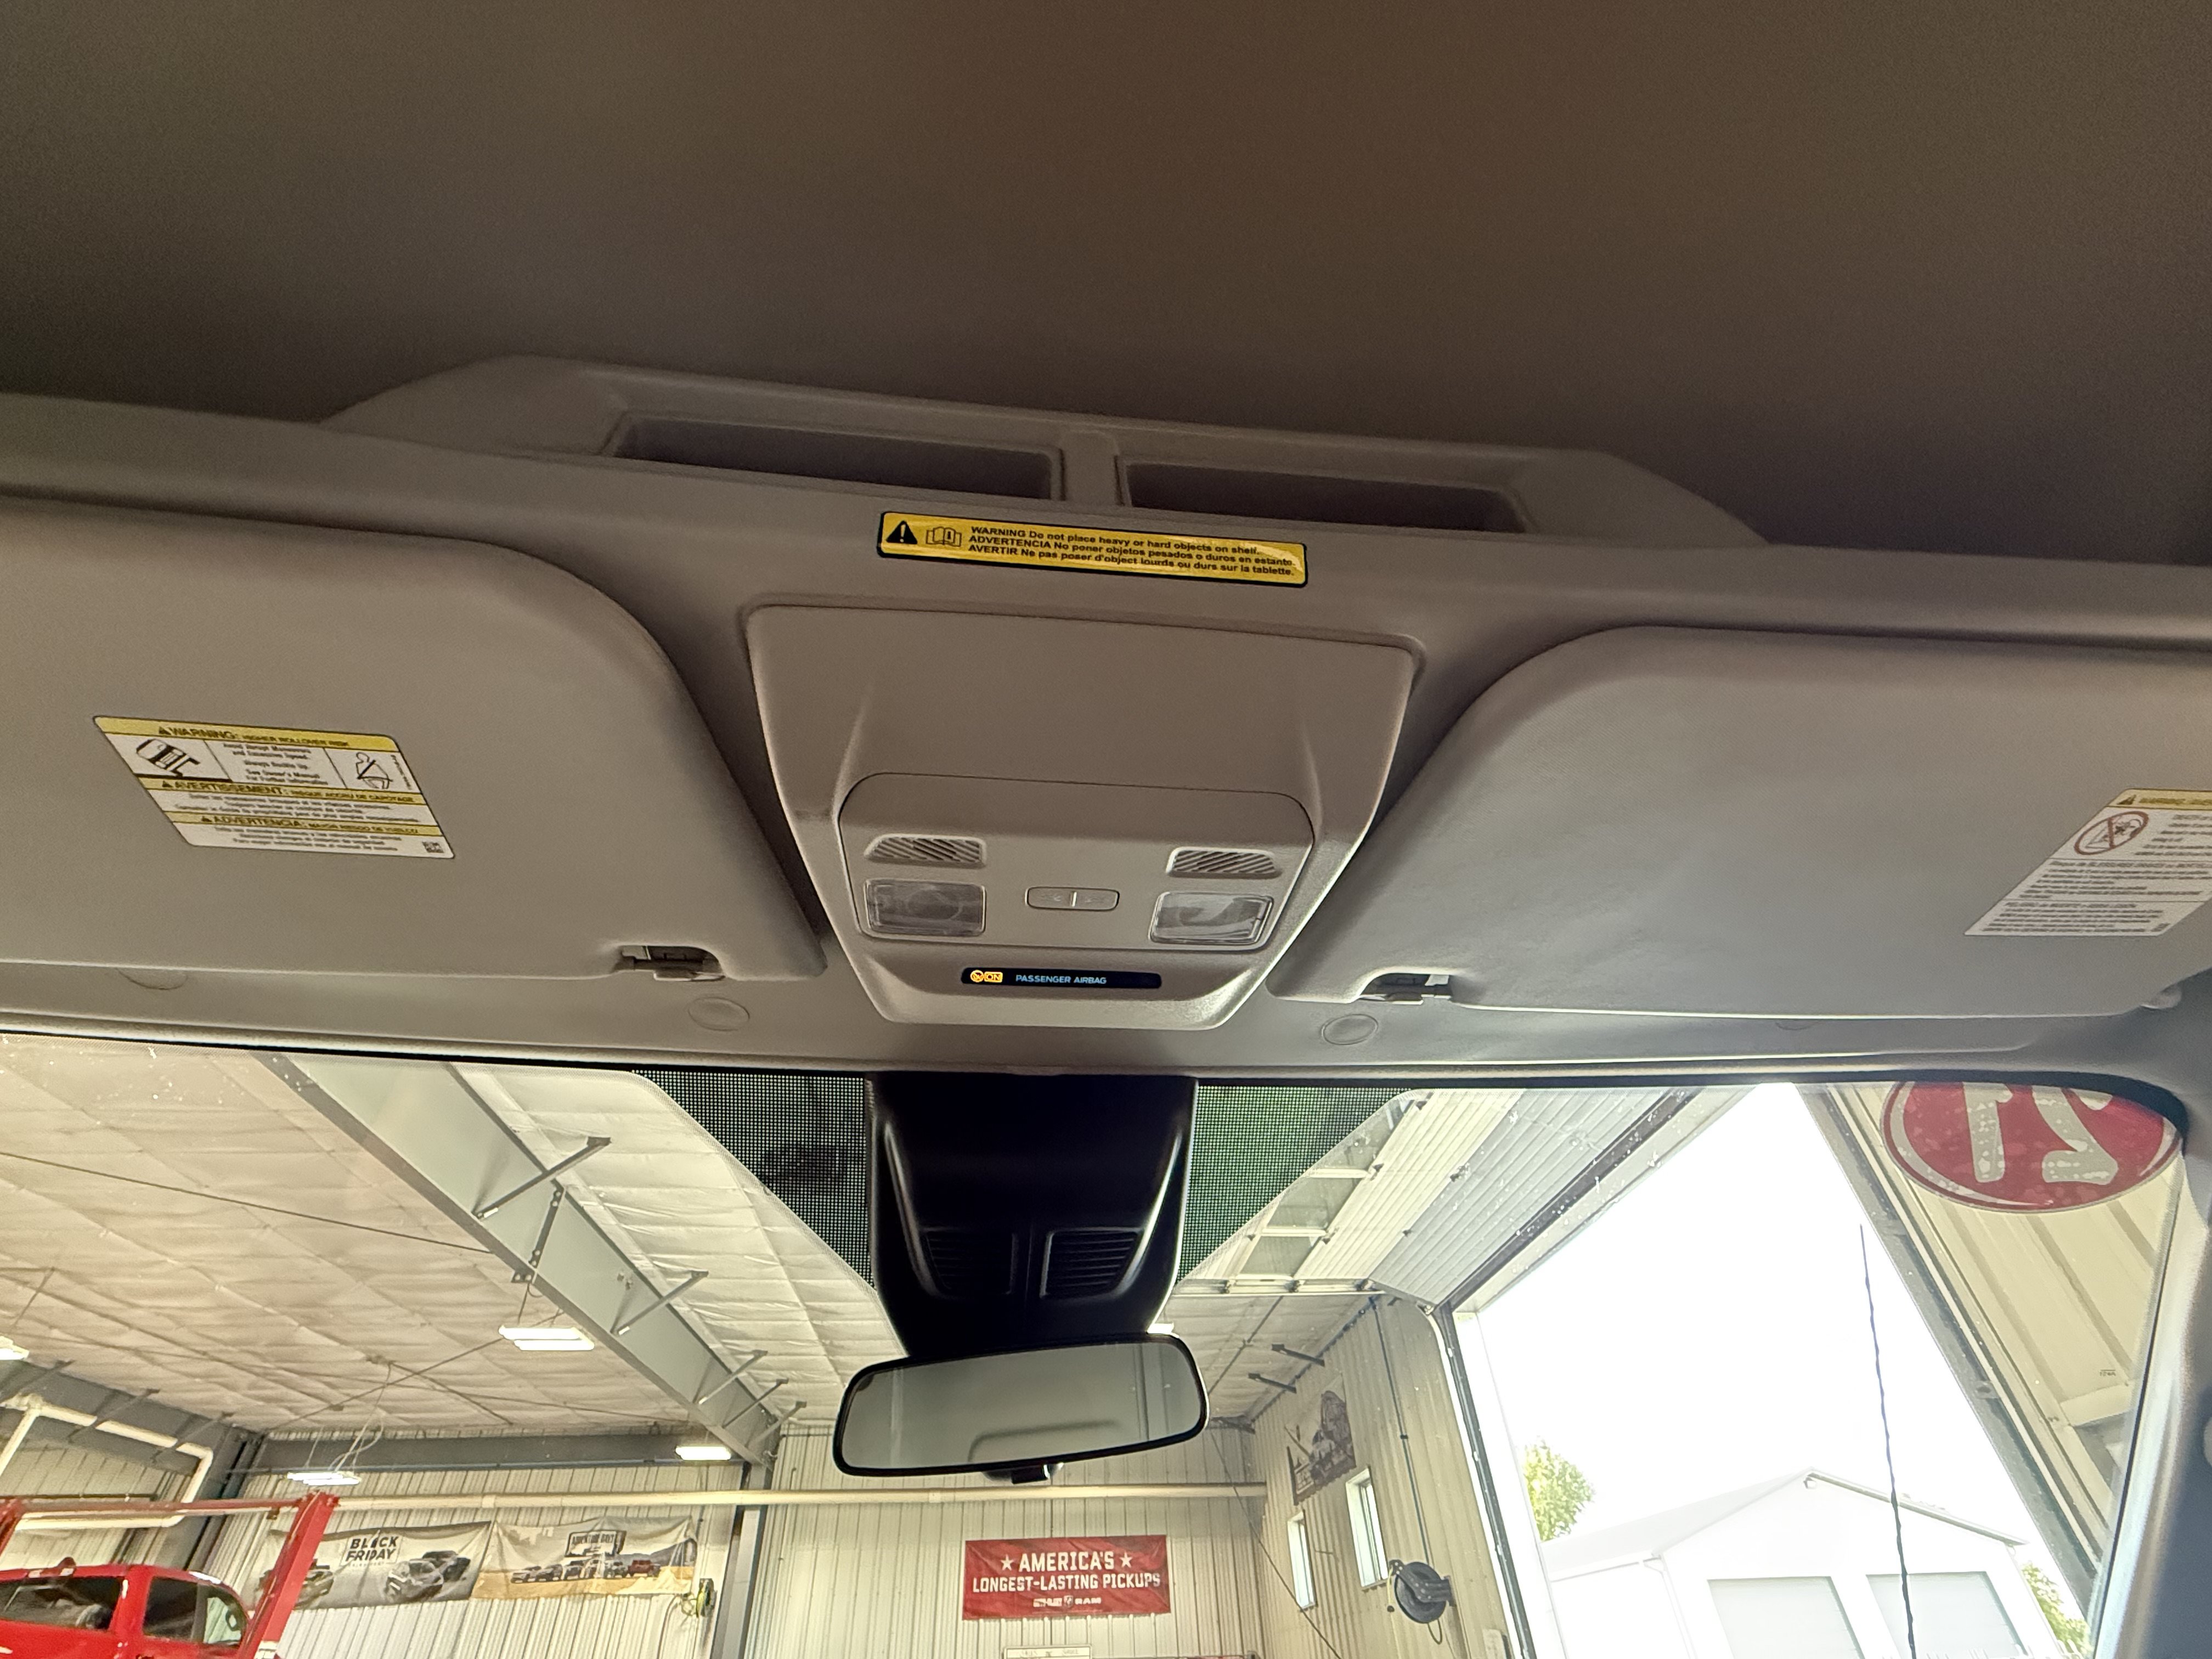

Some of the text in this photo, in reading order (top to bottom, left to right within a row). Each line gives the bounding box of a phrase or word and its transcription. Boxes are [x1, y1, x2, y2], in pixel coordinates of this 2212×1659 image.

[971, 526, 1025, 537] WARNING
[1029, 531, 1044, 539] Do
[1047, 532, 1064, 540] not
[1067, 534, 1096, 544] place
[1099, 537, 1131, 546] heavy
[1147, 540, 1171, 549] hard
[1173, 542, 1212, 552] objects
[968, 535, 1050, 549] ADVERTENCIA
[1071, 544, 1103, 553] poner
[1105, 546, 1146, 556] objetos
[1148, 550, 1193, 560] pesados
[1205, 553, 1235, 562] duros
[968, 544, 1018, 555] AVERTIR
[1020, 549, 1036, 557] Ne
[1038, 551, 1058, 560] pas
[1061, 553, 1091, 561] poser
[1141, 558, 1175, 567] lourds
[1193, 561, 1217, 571] durs
[1252, 566, 1295, 576] tablette.
[168, 726, 238, 740] WARNING:
[1015, 974, 1107, 984] PASSENGER AIRBAG
[349, 1536, 399, 1549] BLACK
[345, 1549, 396, 1561] FRIDAY
[1018, 1550, 1115, 1573] AMERICA'S
[972, 1572, 1161, 1593] LONGEST-LASTING PICKUPS
[1075, 1597, 1102, 1605] RAM
